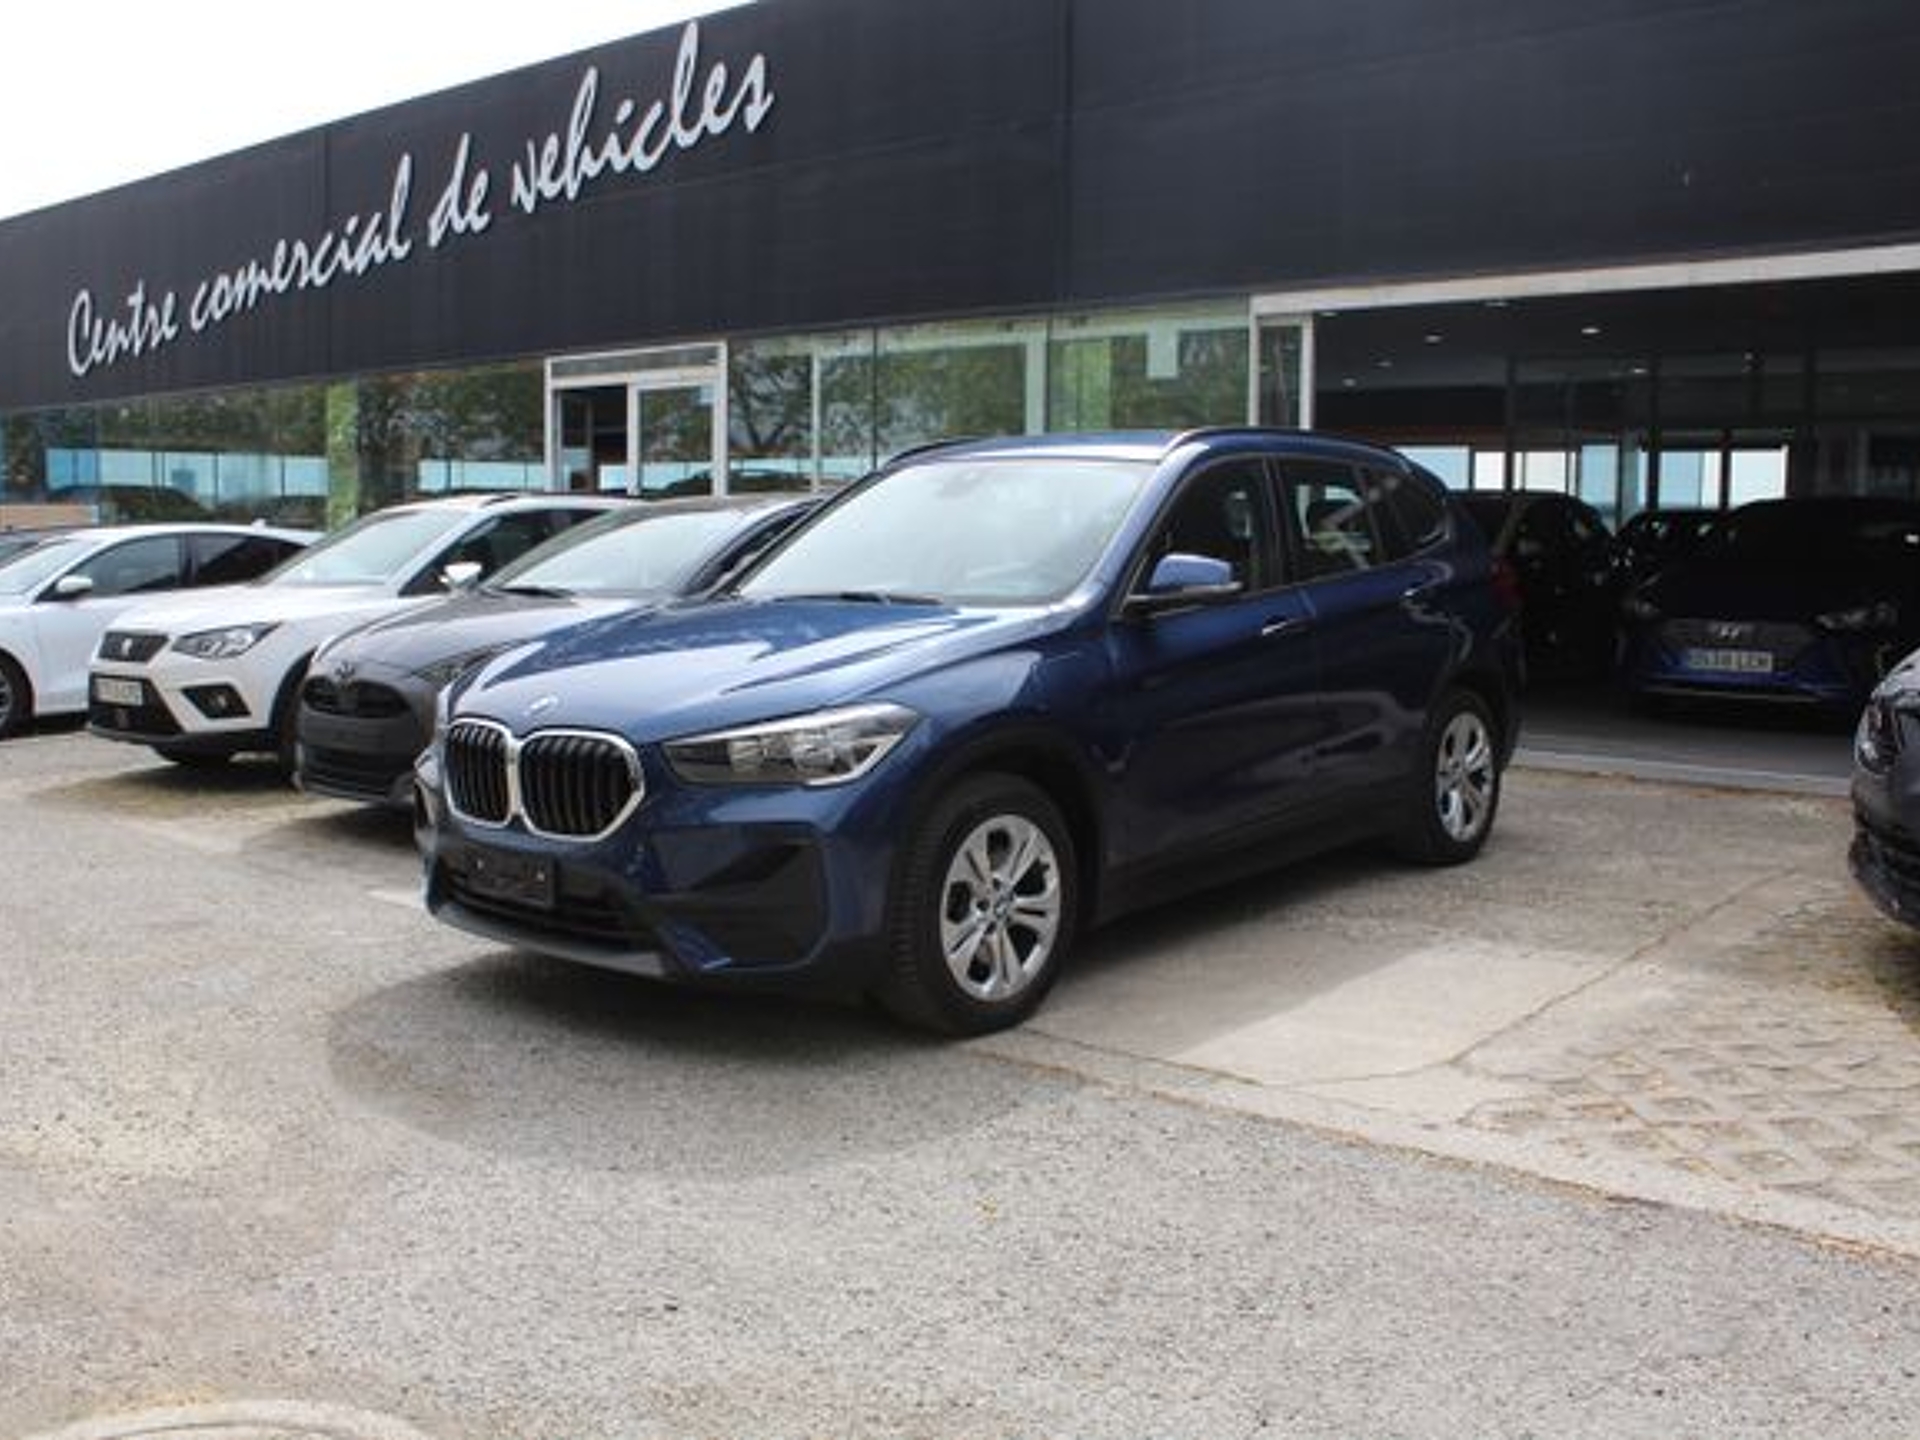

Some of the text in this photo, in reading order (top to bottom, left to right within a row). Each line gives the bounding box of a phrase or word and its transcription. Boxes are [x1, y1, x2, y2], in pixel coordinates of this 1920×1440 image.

[68, 20, 774, 376] Centre comercial de vehicles
